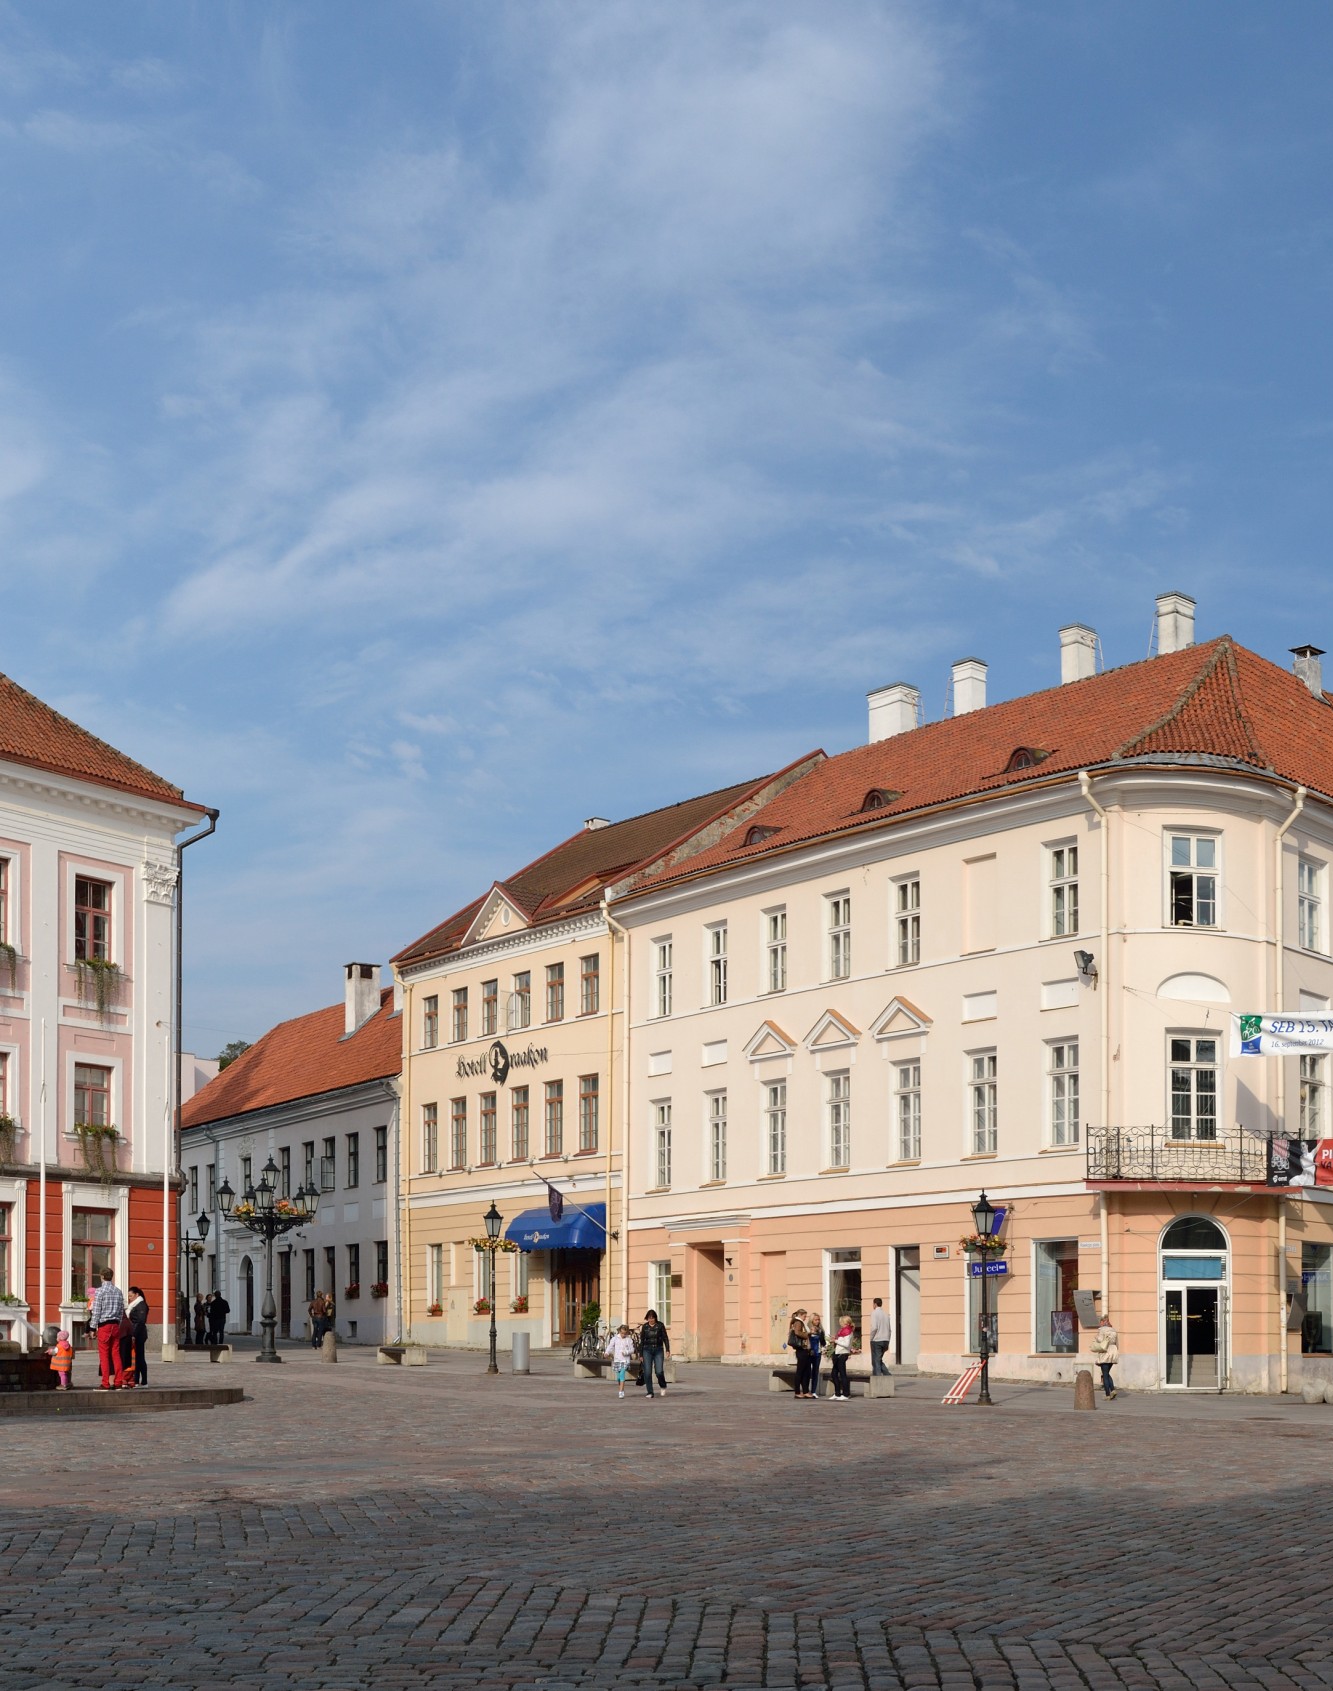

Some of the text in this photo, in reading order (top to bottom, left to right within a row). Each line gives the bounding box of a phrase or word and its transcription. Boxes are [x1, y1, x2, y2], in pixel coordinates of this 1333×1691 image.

[1270, 1020, 1296, 1034] SEB
[1299, 1021, 1319, 1033] 15.
[974, 1264, 999, 1274] Jueel
